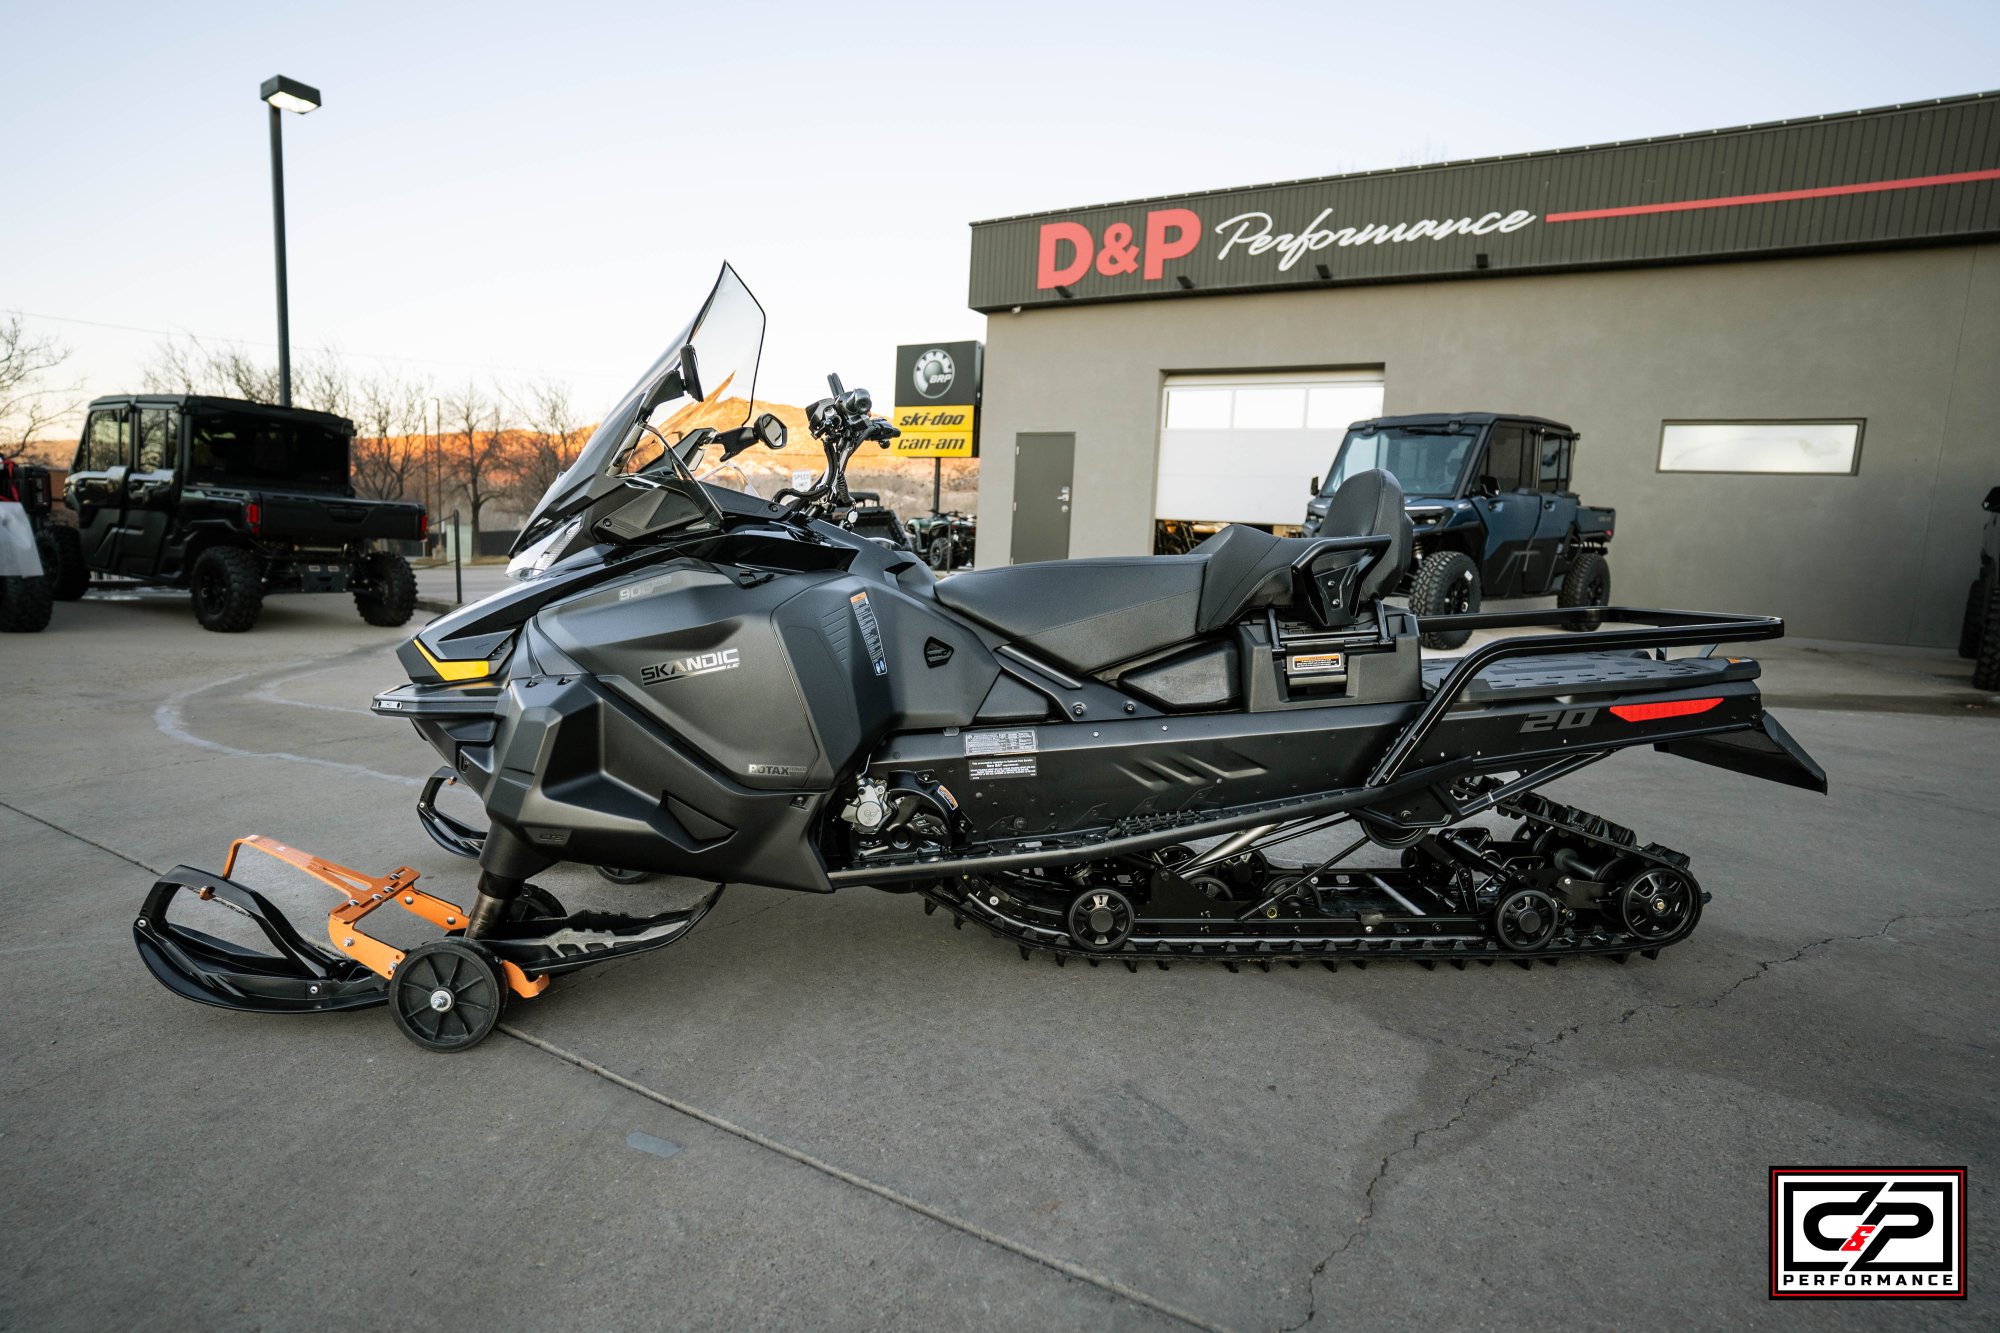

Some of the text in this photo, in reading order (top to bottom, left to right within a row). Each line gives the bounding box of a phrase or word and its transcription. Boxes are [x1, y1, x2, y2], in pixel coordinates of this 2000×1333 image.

[1037, 207, 1537, 290] D&P Performance
[929, 373, 952, 384] BRP
[899, 412, 965, 426] ski-doo
[897, 438, 965, 450] can-am
[640, 648, 740, 681] SKANDIC
[1519, 707, 1600, 734] 20
[749, 764, 790, 776] ROTAX
